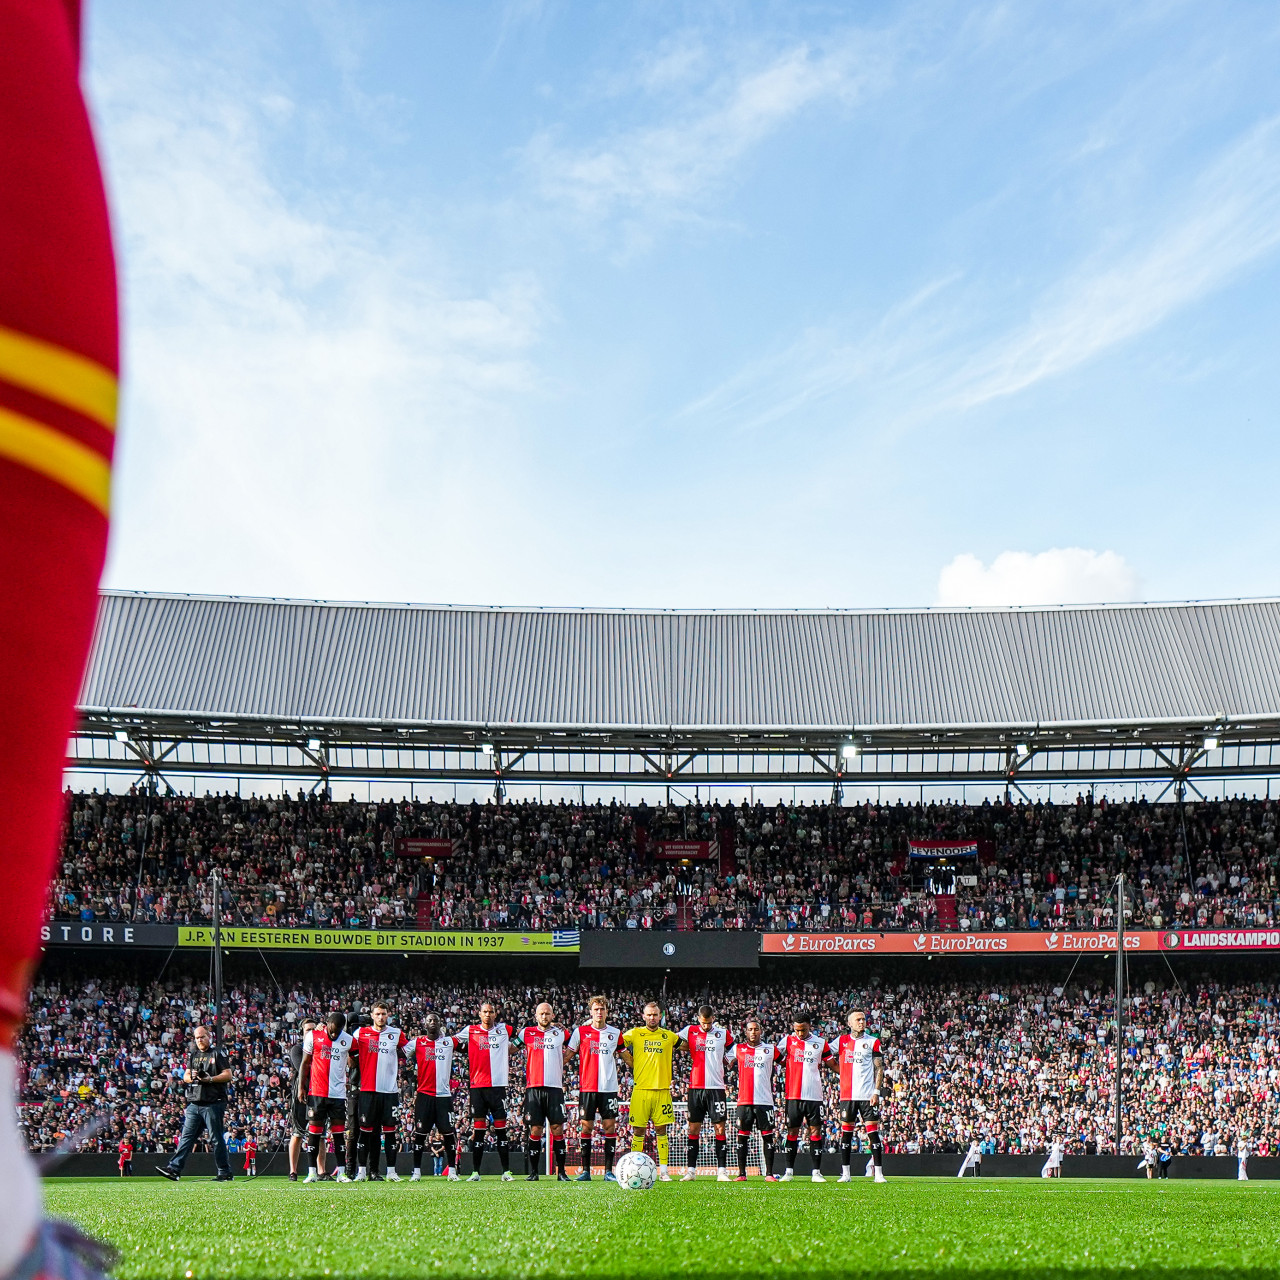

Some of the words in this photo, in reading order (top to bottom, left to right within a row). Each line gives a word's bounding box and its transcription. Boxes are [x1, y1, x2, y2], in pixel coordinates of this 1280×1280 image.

[911, 845, 978, 857] FEYENOORD
[40, 926, 134, 942] STORE
[185, 931, 206, 942] J.P.
[241, 932, 310, 944] EESTEREN
[315, 934, 372, 945] BOUWDE
[376, 935, 397, 945] DIT
[400, 935, 456, 947] STADION
[461, 935, 474, 947] IN
[478, 936, 505, 947] 1937
[930, 935, 1008, 950] EuroParcs
[799, 936, 876, 951] EuroParcs
[370, 1039, 387, 1047] Euro
[590, 1040, 607, 1048] Euro
[696, 1037, 713, 1045] Euro
[322, 1045, 339, 1053] Euro
[368, 1046, 388, 1054] Parcs
[590, 1047, 608, 1055] Parcs
[696, 1044, 715, 1052] Parcs
[795, 1048, 812, 1056] Euro
[321, 1051, 340, 1060] Parcs
[425, 1053, 445, 1061] Parcs
[794, 1055, 813, 1063] Parcs
[844, 1055, 863, 1064] Parcs
[608, 1098, 619, 1110] 20
[714, 1101, 726, 1113] 33
[662, 1104, 673, 1115] 22
